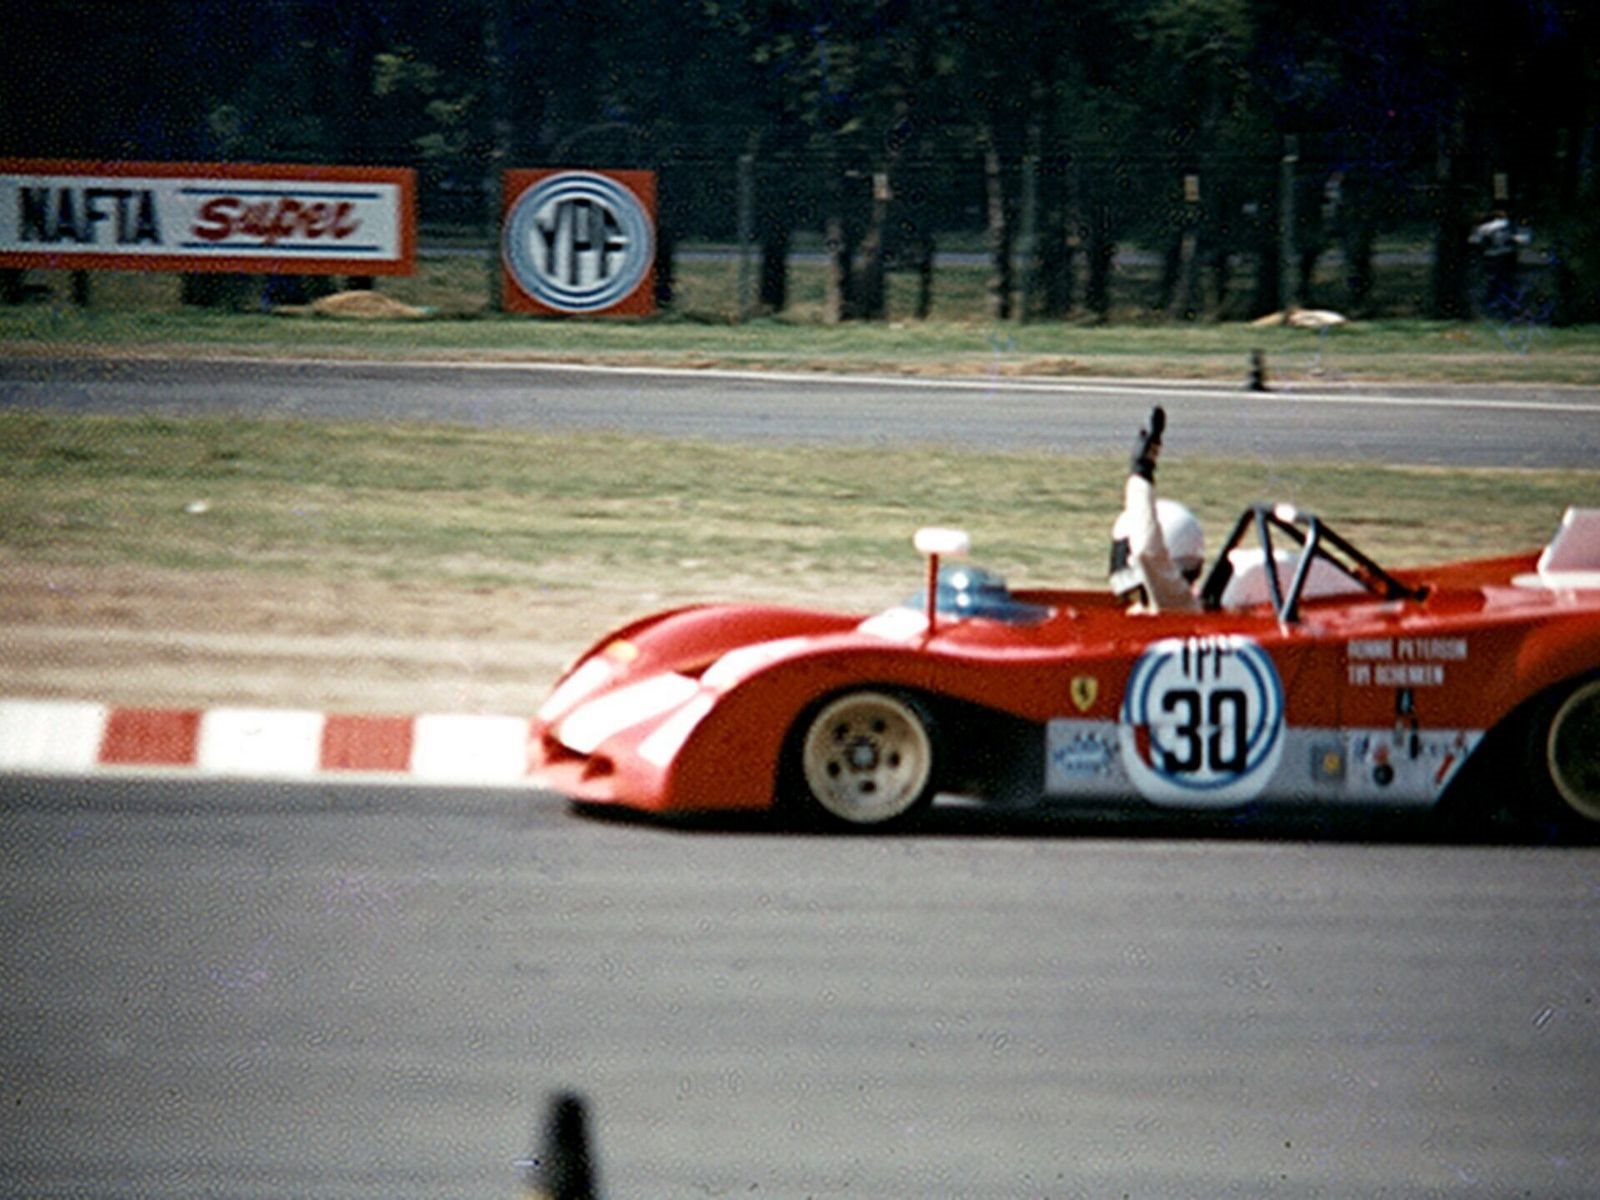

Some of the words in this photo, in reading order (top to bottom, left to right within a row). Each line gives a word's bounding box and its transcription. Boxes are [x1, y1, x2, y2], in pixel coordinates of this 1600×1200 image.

[19, 186, 161, 244] NAFTA
[535, 199, 627, 286] YPF
[1162, 689, 1247, 773] 30
